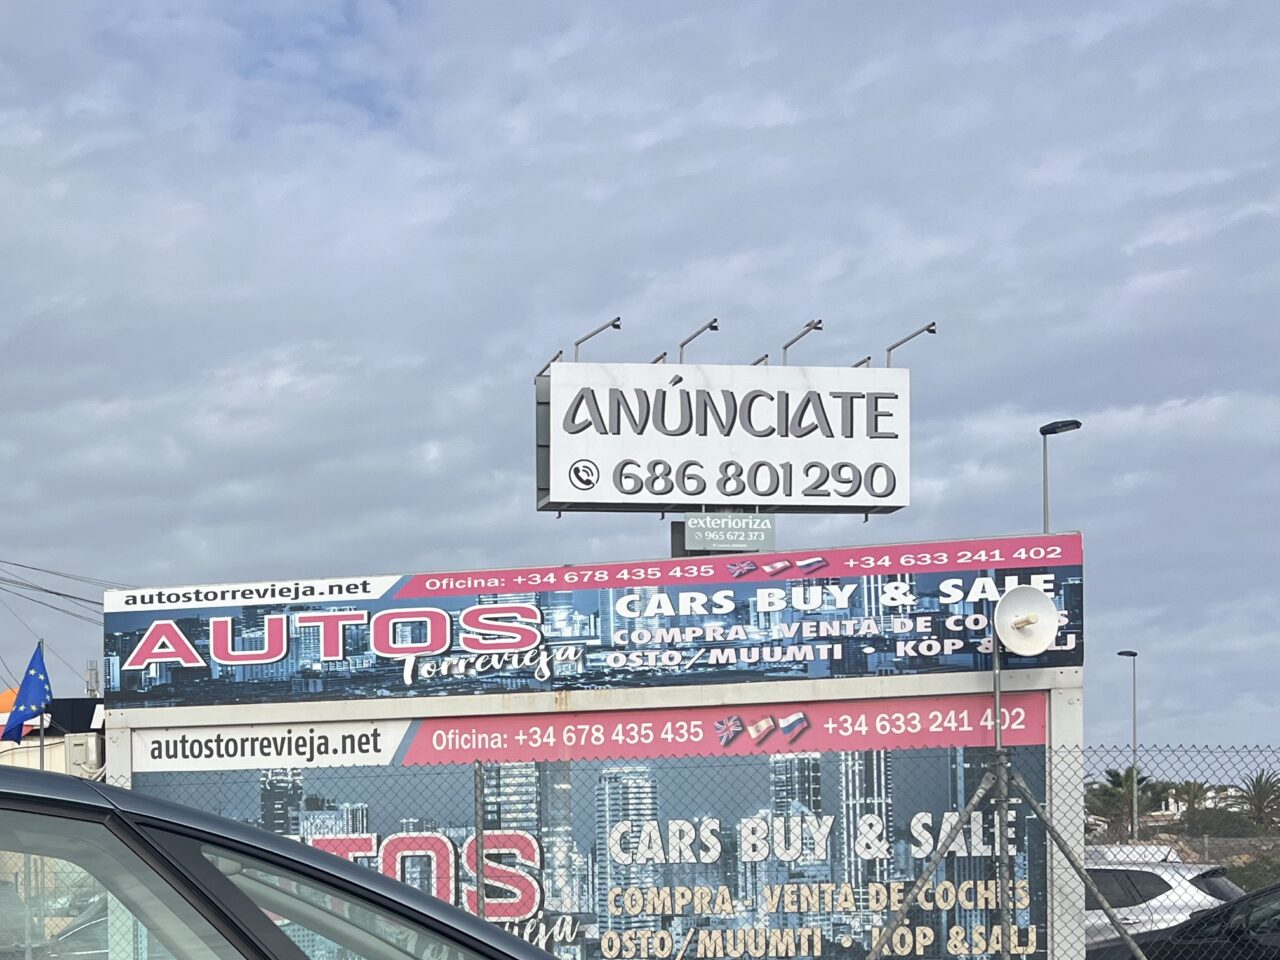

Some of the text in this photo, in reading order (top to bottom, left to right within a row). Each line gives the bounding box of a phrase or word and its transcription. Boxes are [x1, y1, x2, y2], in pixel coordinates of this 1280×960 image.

[562, 374, 899, 438] ANÚNCIATE
[612, 459, 897, 498] 686 801 290
[688, 515, 771, 529] exterioriza
[704, 531, 765, 541] 965 672 373
[844, 546, 1062, 569] +34 633 241 402
[425, 564, 715, 591] Oficina: +34 678 435 435
[124, 580, 371, 606] autostorrevieja.net
[615, 589, 736, 618] CARS
[756, 583, 858, 612] BUY
[879, 582, 917, 606] &
[121, 604, 544, 671] AUTOS
[614, 624, 748, 645] COMPRA
[781, 617, 880, 639] VENTA
[893, 615, 932, 634] DE
[897, 635, 965, 657] KÖP
[393, 643, 584, 686] Torrevieja
[432, 721, 704, 751] Oficina: +34 678 435 435
[823, 714, 868, 736] +34
[875, 712, 921, 735] 633
[928, 710, 973, 732] 241
[150, 727, 382, 762] autostorrevieja.net
[609, 811, 1017, 865] CARS BUY & SALE
[606, 885, 736, 916] COMPRA
[764, 883, 857, 913] VENTA
[868, 881, 906, 912] DE
